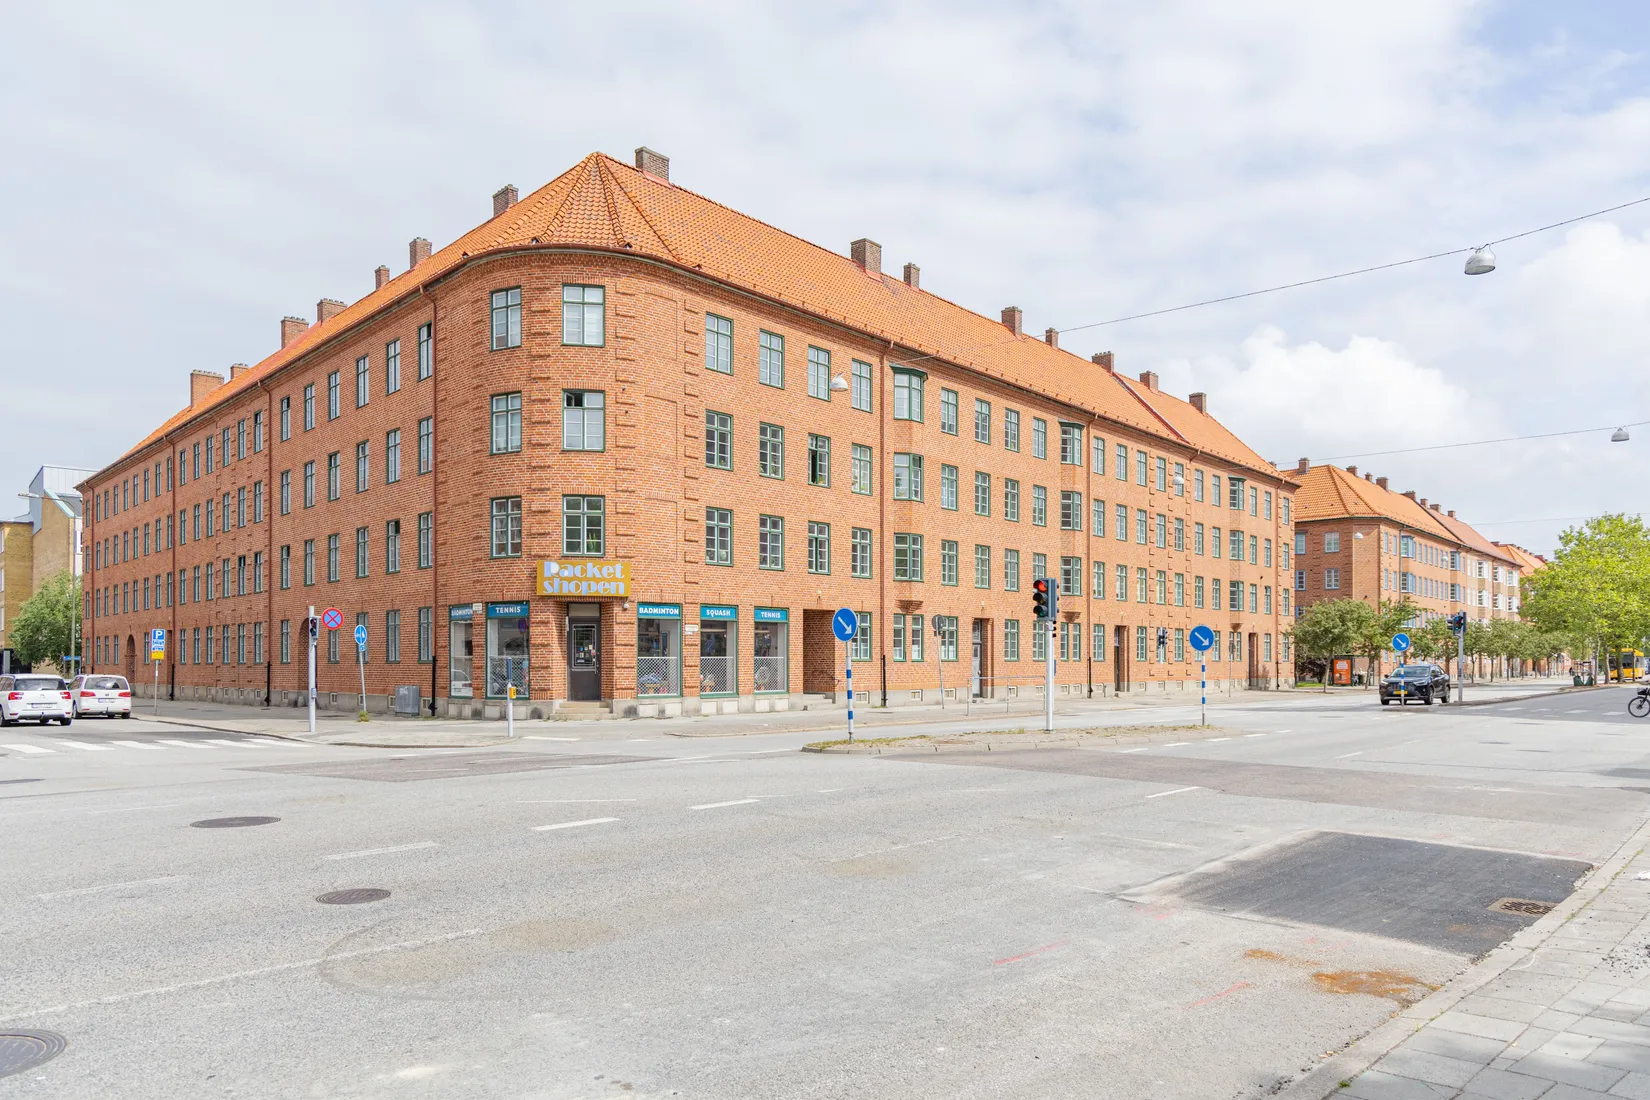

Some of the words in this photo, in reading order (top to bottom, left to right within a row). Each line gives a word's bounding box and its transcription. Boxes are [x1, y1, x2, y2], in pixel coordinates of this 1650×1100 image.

[543, 561, 625, 579] Racket
[543, 577, 625, 596] shopen
[495, 606, 521, 614] TENNIS
[639, 607, 679, 615] BADMINTON
[706, 609, 731, 618] SQUASH
[760, 611, 781, 619] TENNIS
[155, 630, 163, 639] P
